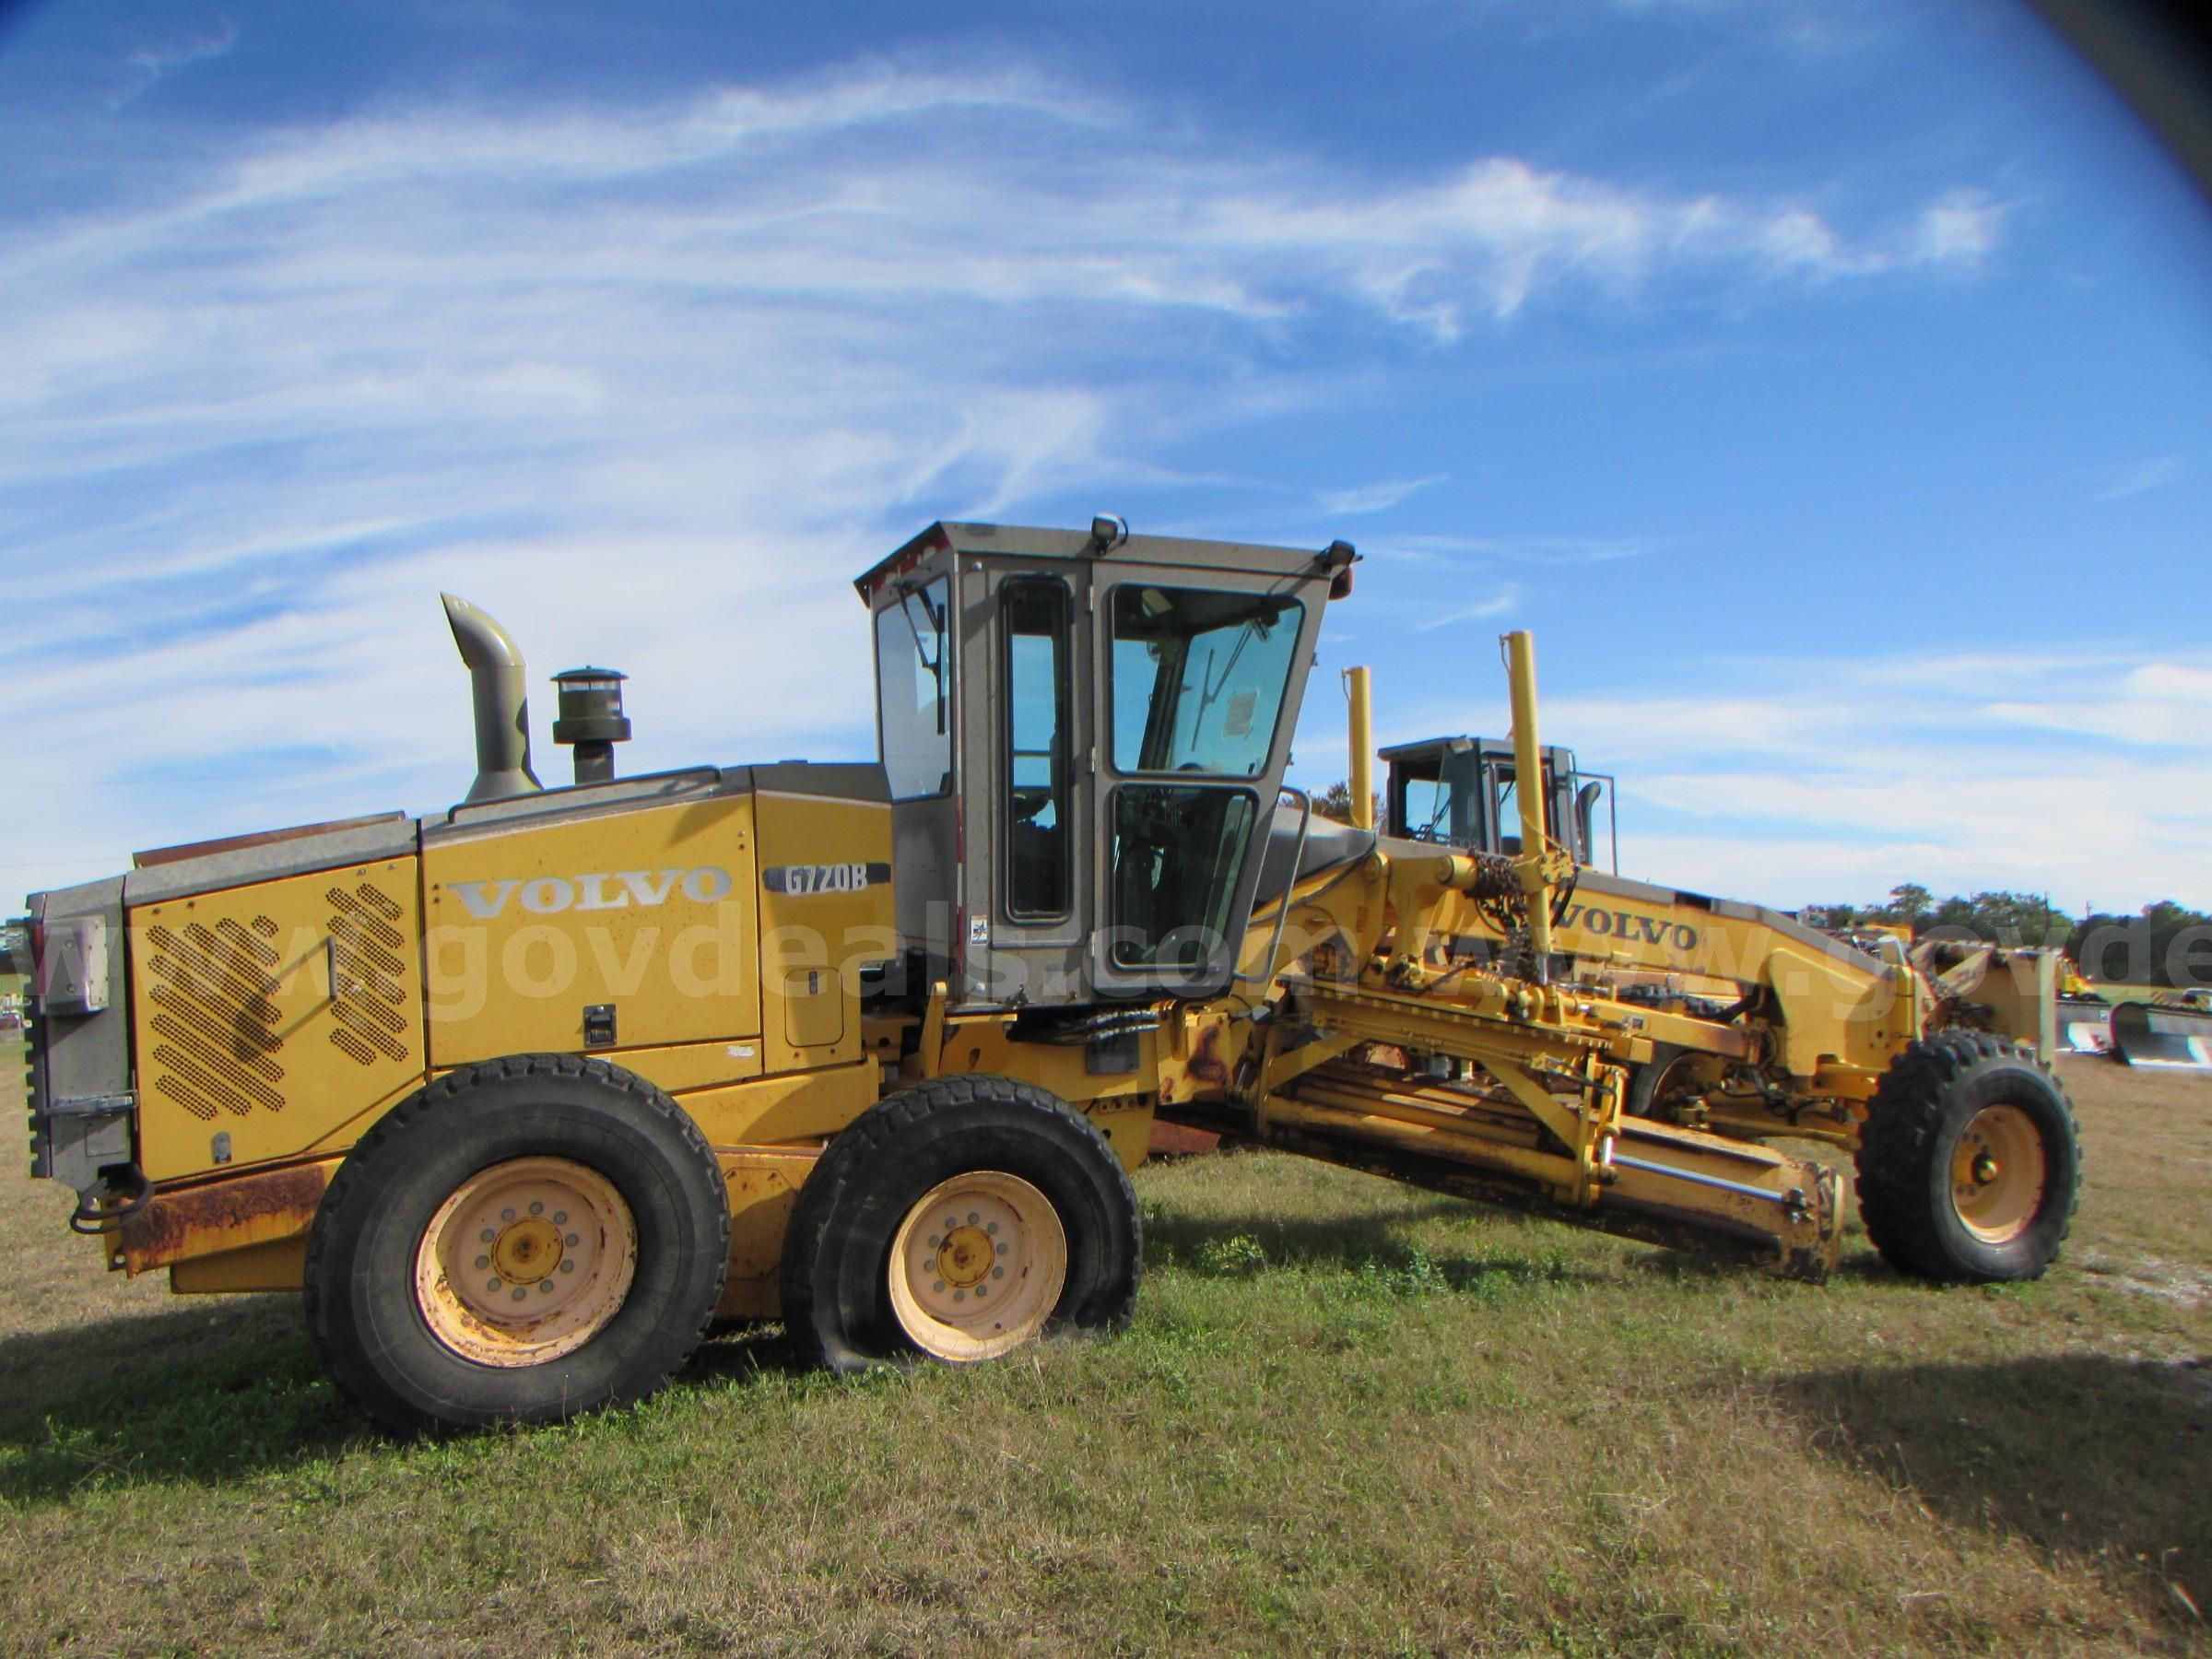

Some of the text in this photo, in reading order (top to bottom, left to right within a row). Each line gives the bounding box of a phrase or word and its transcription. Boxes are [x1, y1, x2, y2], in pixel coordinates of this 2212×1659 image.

[446, 865, 733, 919] VOLVO
[785, 862, 868, 897] G720B
[1552, 900, 1697, 951] VOLVO
